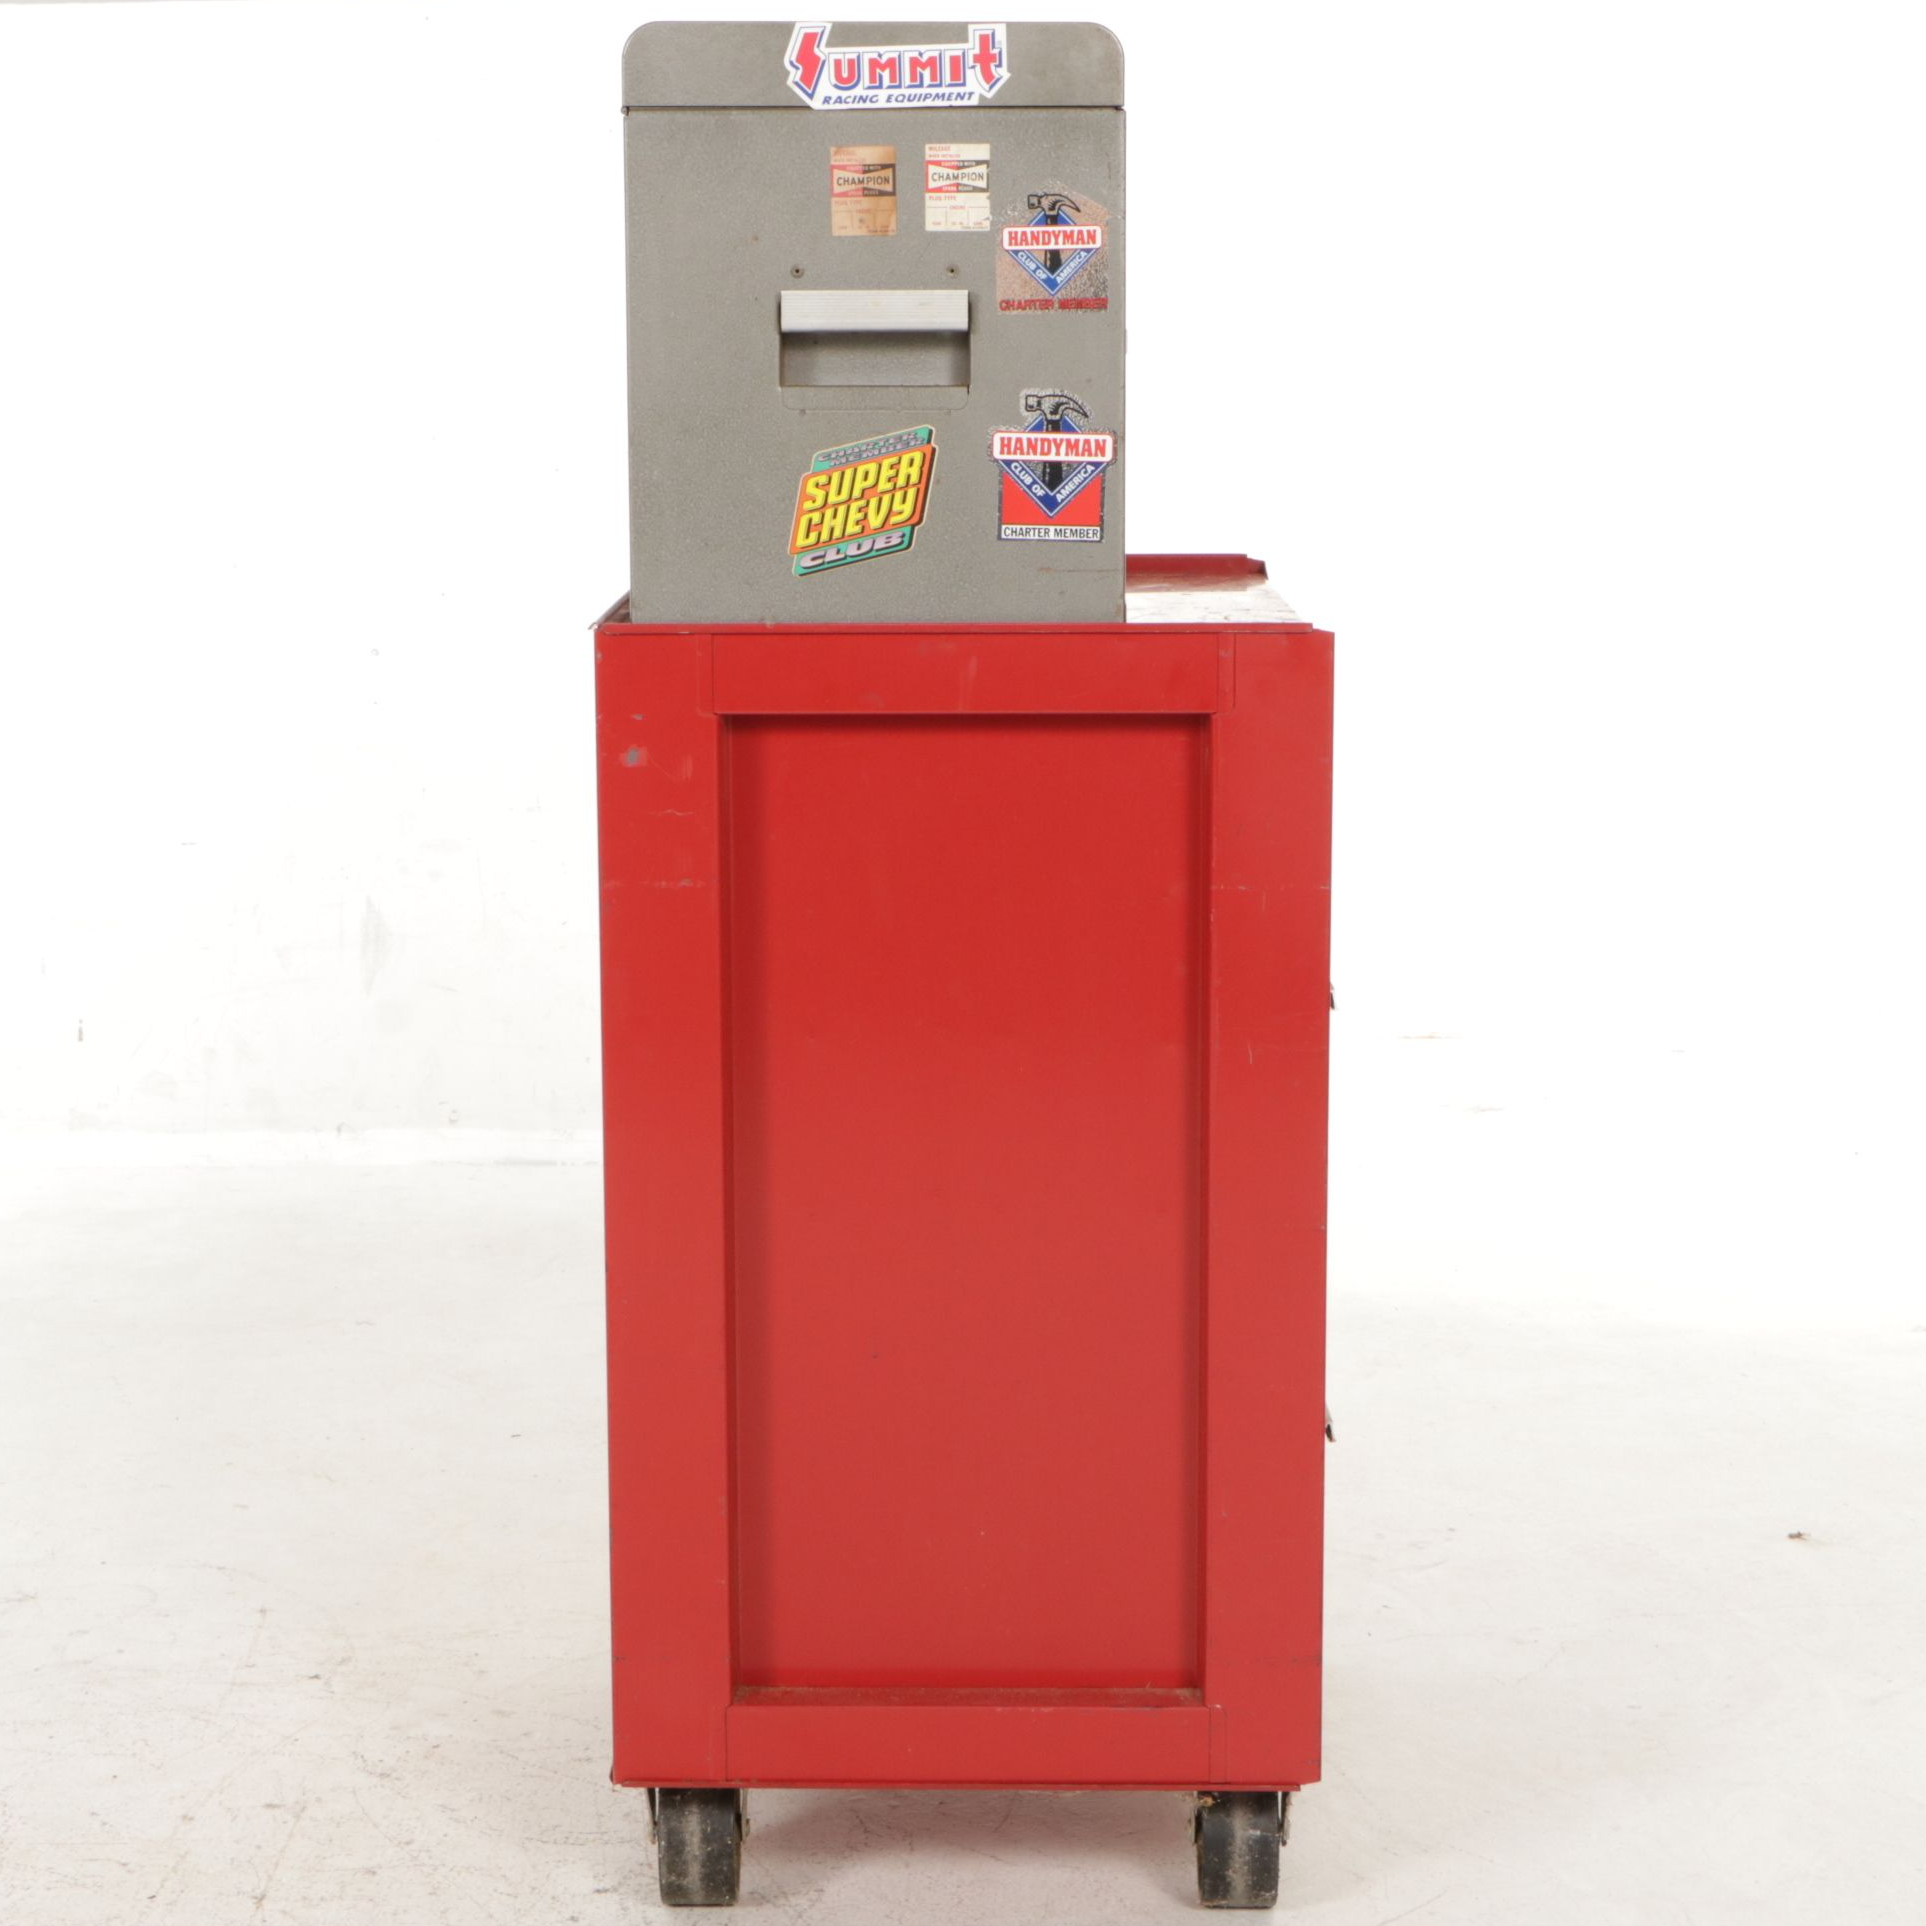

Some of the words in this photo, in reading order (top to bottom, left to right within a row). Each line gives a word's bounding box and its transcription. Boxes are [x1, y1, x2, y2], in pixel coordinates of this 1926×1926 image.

[821, 93, 879, 105] RACING
[885, 91, 975, 103] EQUIPMENT
[836, 175, 890, 186] CHAMPION
[931, 172, 984, 182] CHAMPION
[1008, 229, 1097, 246] HANDYMAN
[1017, 251, 1037, 270] CLUB
[1036, 267, 1048, 280] OF
[1055, 250, 1088, 283] AMERICA
[1000, 436, 1107, 457] HANDYMAN
[803, 450, 924, 511] SUPER
[1010, 461, 1032, 485] CLUB
[1031, 483, 1046, 497] OF
[1055, 464, 1095, 503] AMERICA
[796, 486, 918, 548] CHEVY
[1003, 526, 1050, 538] CHARTER
[1054, 527, 1099, 539] MEMBER
[799, 531, 906, 568] CLUB
